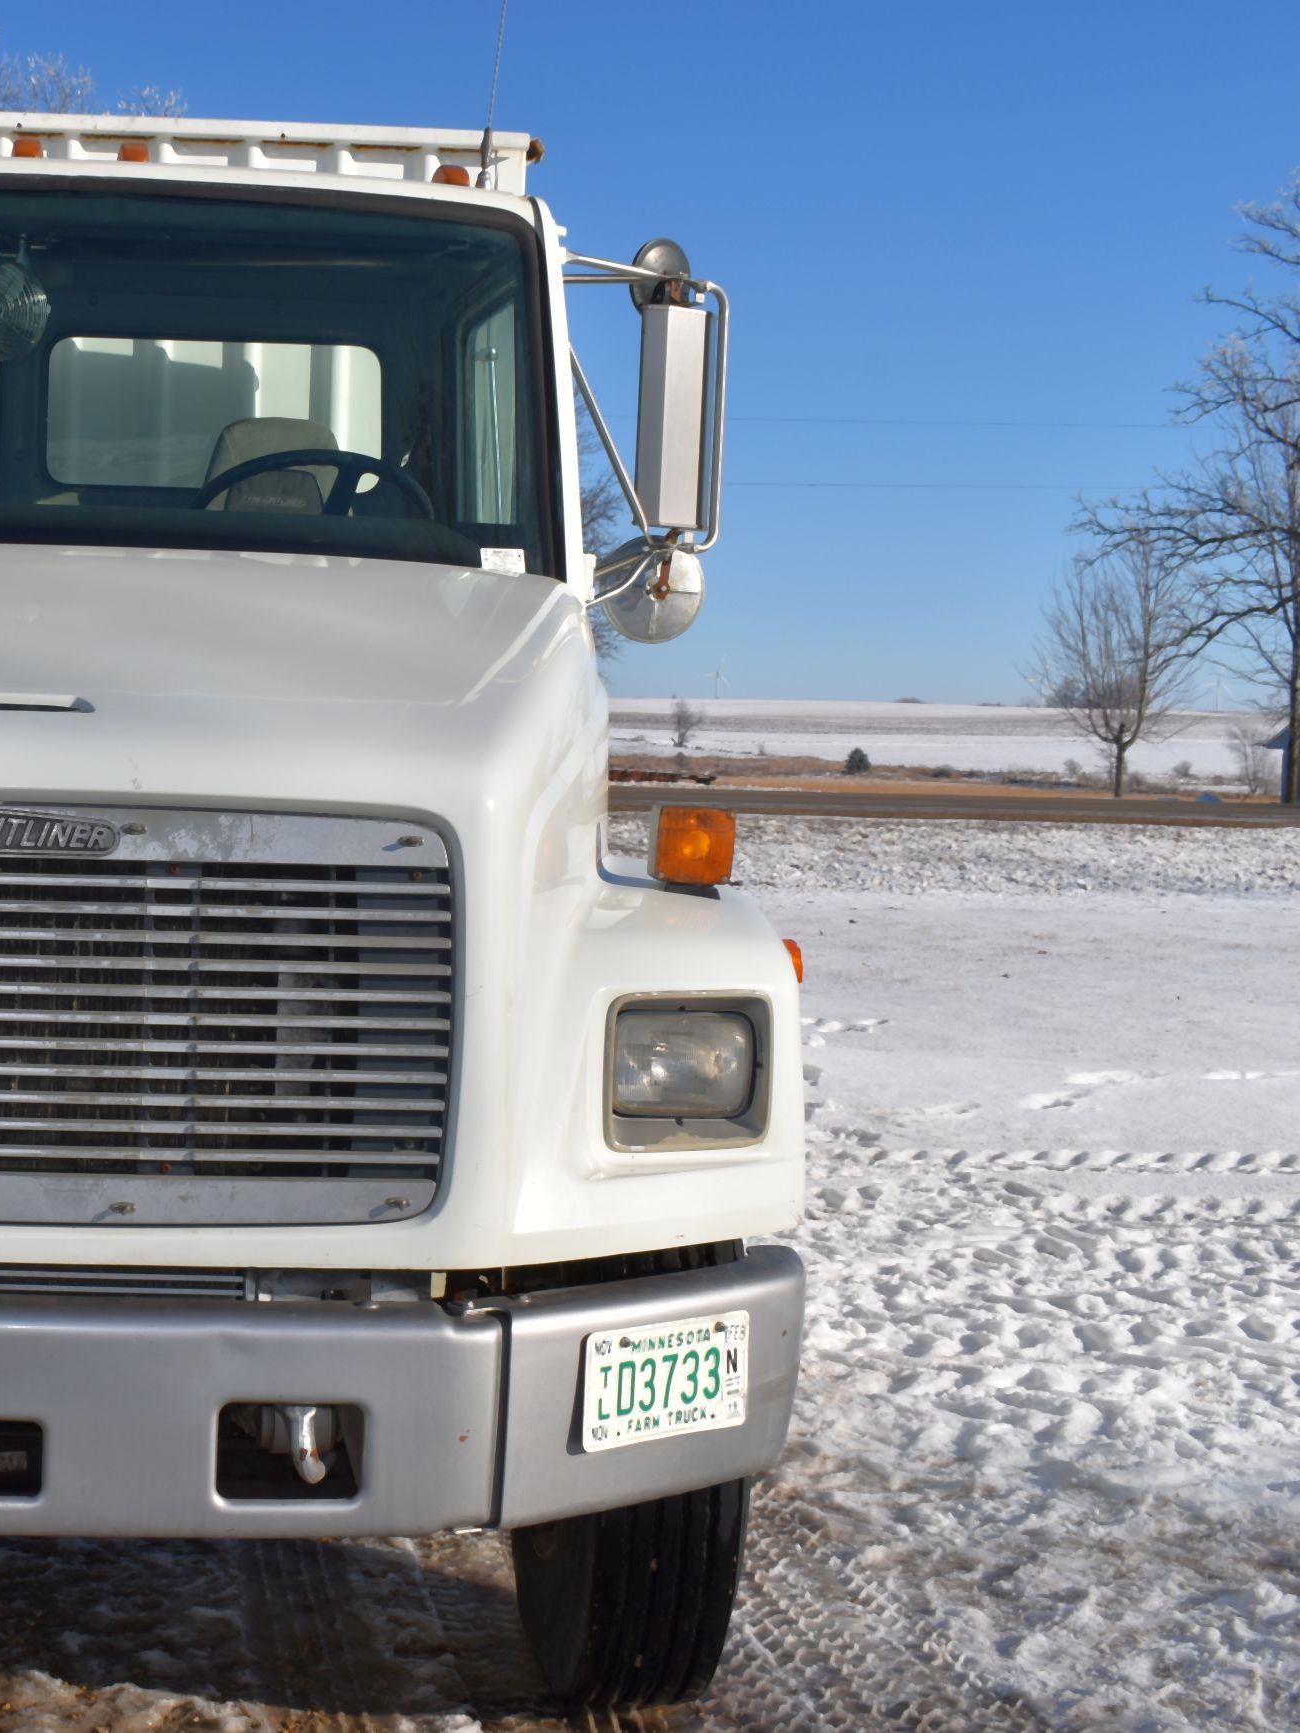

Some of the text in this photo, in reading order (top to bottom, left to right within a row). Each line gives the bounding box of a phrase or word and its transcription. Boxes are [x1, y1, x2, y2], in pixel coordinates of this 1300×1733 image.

[631, 1328, 711, 1352] MINNESOTA
[726, 1347, 738, 1375] N
[627, 1407, 707, 1434] FARM TRUCK
